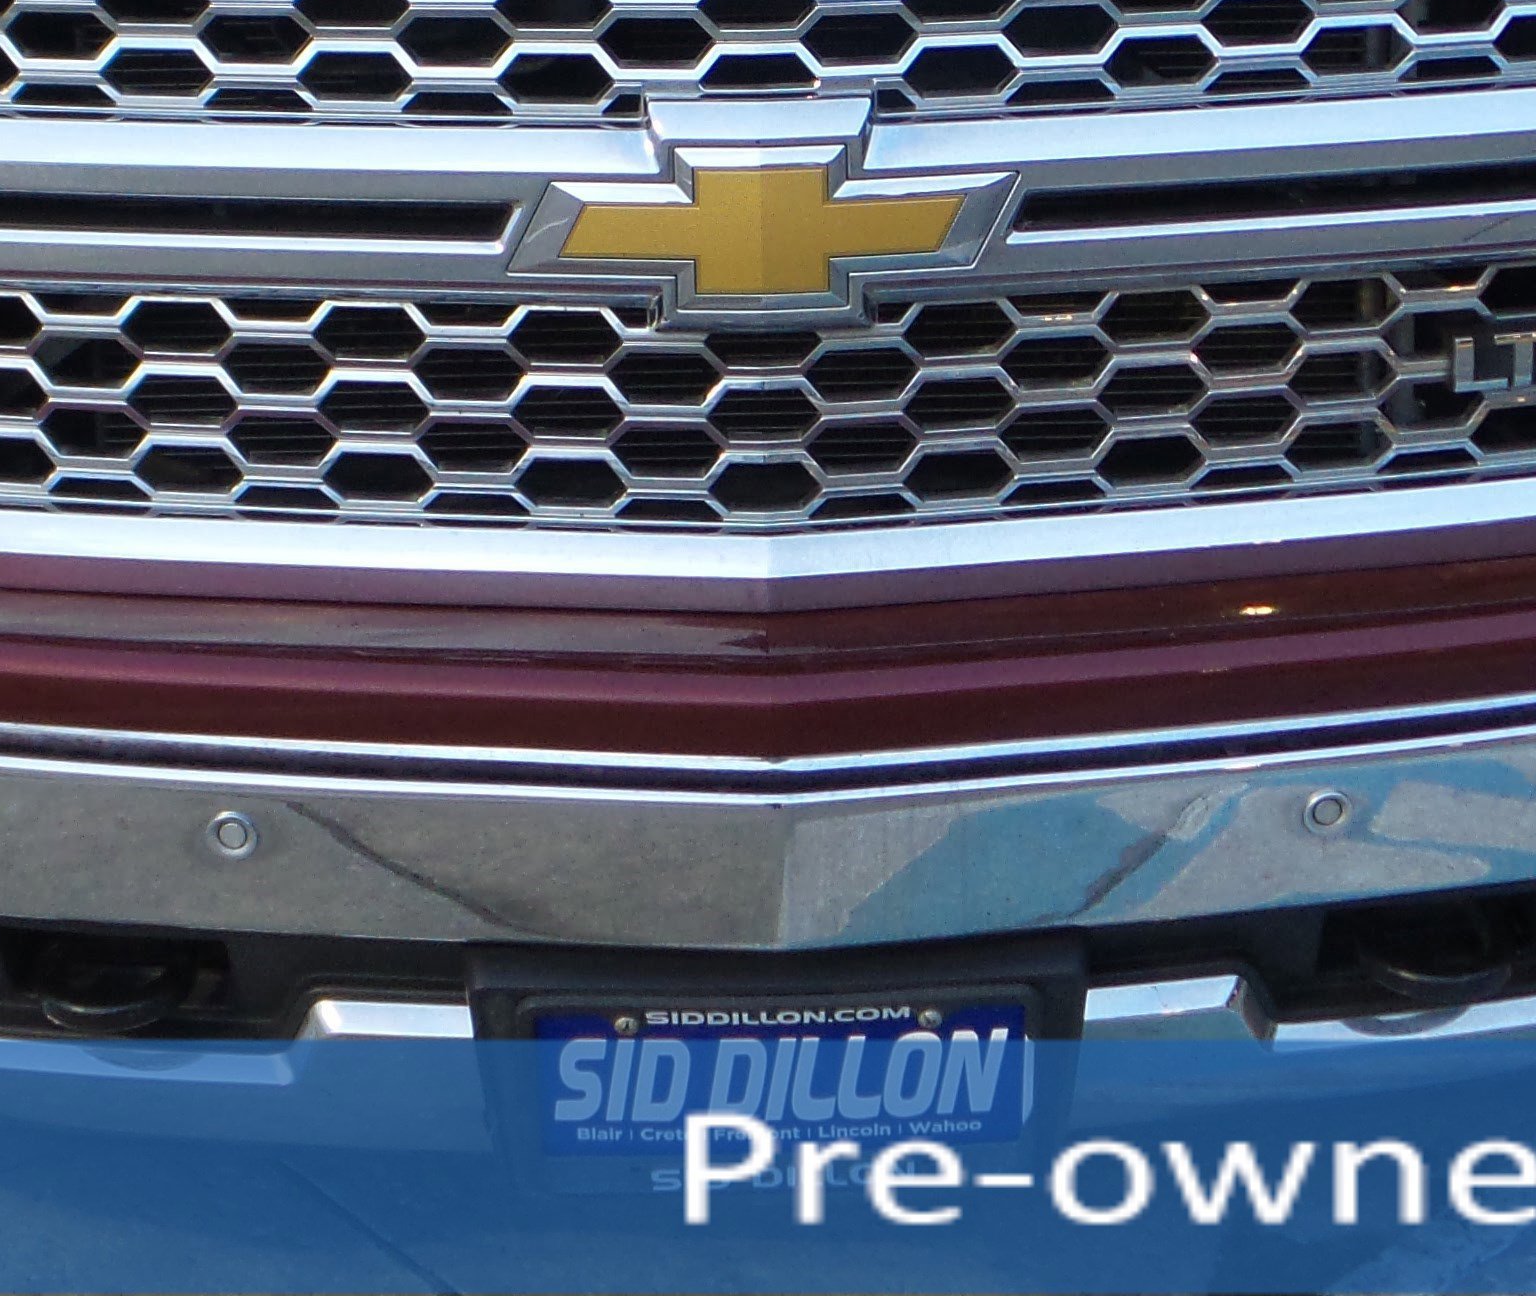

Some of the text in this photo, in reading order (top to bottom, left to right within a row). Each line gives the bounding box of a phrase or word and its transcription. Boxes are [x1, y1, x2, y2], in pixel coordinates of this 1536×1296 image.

[645, 1006, 911, 1025] SIDDILLON.COM
[554, 1028, 1009, 1122] SID DILLON
[577, 1120, 982, 1142] Blair Cret Freont Lincoln Wahoo
